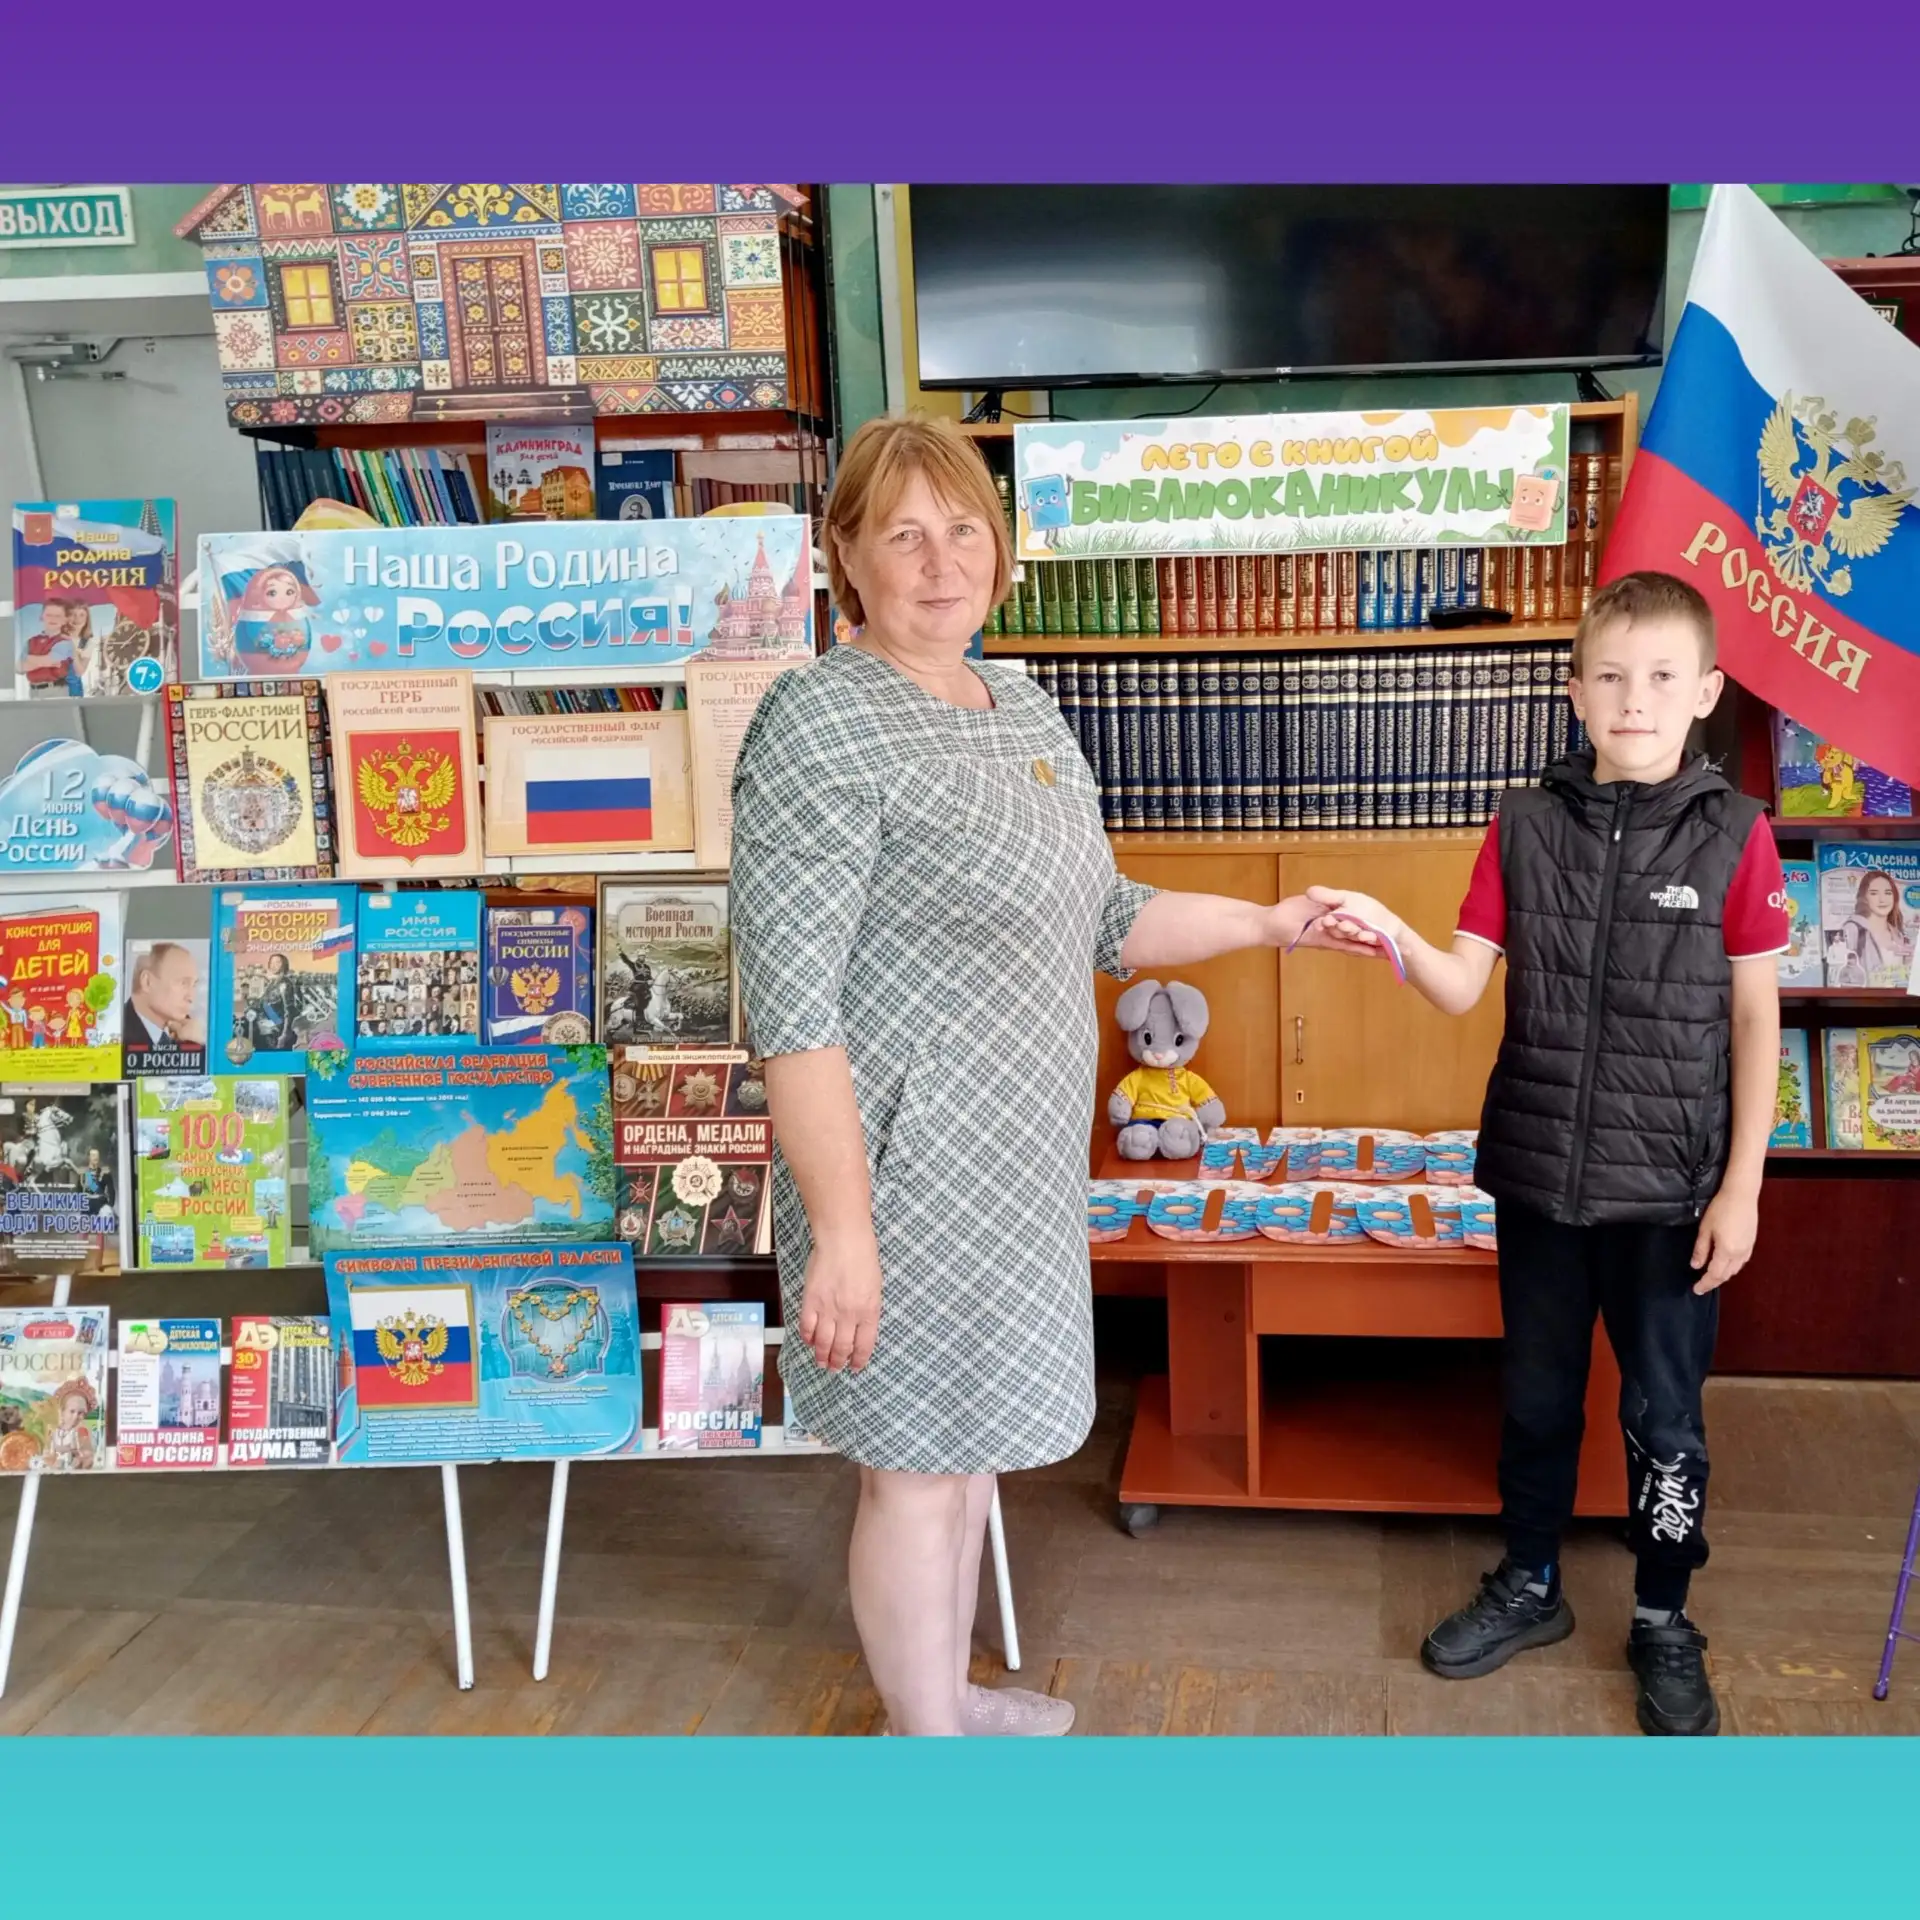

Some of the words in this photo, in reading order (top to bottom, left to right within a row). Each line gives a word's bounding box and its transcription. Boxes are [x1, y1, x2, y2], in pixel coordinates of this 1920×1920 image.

[0, 200, 119, 235] ВЫХОД
[496, 438, 583, 455] КАЛИНИНГРАД
[1141, 440, 1241, 472] ЛЕТО
[1249, 441, 1273, 467] С
[1281, 428, 1439, 465] КНИГОЙ
[1070, 466, 1515, 527] БИБЛИОКАНИКУЛЫ
[74, 530, 119, 543] Наша
[56, 549, 132, 567] родина
[344, 546, 481, 591] Наша
[497, 540, 679, 591] Родина
[44, 567, 147, 589] РОССИЯ
[1680, 521, 1872, 694] РОССИЯ
[135, 666, 158, 686] 7+
[341, 676, 458, 691] ГОСУДАРСТВЕННЫЙ
[700, 671, 780, 683] ГОСУДАРСТВЕ
[733, 681, 770, 695] ГИМ
[379, 690, 422, 704] ГЕРБ
[343, 706, 403, 716] РОССИЙСКОЙ
[406, 704, 460, 714] ФЕДЕРАЦИИ
[191, 719, 303, 743] РОССИИ
[512, 721, 625, 735] ГОСУДАРСТВЕННЫЙ
[630, 721, 661, 732] ФЛАГ
[531, 734, 588, 745] РОССИЙСКОЙ
[591, 734, 643, 744] ФЕДЕРАЦИИ
[1130, 713, 1140, 778] ЭНЦИКЛОПЕДИЯ
[1150, 713, 1160, 778] ЭНЦИКЛОПЕДИЯ
[1170, 713, 1180, 777] ЭНЦИКЛОПЕДИЯ
[1211, 712, 1220, 778] ЭНЦИКЛОПЕДИЯ
[1230, 712, 1240, 778] ЭНЦИКЛОПЕДИЯ
[1251, 712, 1260, 778] ЭНЦИКЛОПЕДИЯ
[1271, 712, 1279, 778] ЭНЦИКЛОПЕДИЯ
[1310, 710, 1318, 776] ЭНЦИКЛОПЕДИЯ
[1328, 711, 1336, 776] ЭНЦИКЛОПЕДИЯ
[1348, 709, 1356, 776] ЭНЦИКЛОПЕДИЯ
[1366, 710, 1375, 776] ЭНЦИКЛОПЕДИЯ
[1386, 709, 1394, 776] ЭНЦИКЛОПЕДИЯ
[1404, 708, 1412, 776] ЭНЦИКЛОПЕДИЯ
[1423, 708, 1432, 776] ЭНЦИКЛОПЕДИЯ
[1441, 707, 1450, 774] ЭНЦИКЛОПЕДИЯ
[1460, 706, 1468, 774] ЭНЦИКЛОПЕДИЯ
[1479, 706, 1488, 773] ЭНЦИКЛОПЕДИЯ
[1498, 704, 1508, 772] ЭНЦИКЛОПЕДИЯ
[43, 769, 87, 800] 12
[1112, 798, 1118, 806] 7
[1130, 798, 1137, 806] 8
[1150, 798, 1156, 806] 9
[1169, 798, 1180, 806] 10
[1189, 798, 1199, 806] 11
[1208, 797, 1219, 806] 12
[1228, 796, 1239, 806] 13
[1248, 796, 1259, 806] 14
[1268, 796, 1278, 806] 15
[1288, 796, 1299, 806] 16
[1306, 796, 1316, 804] 17
[1324, 796, 1335, 805] 18
[1344, 794, 1354, 804] 19
[1362, 795, 1374, 805] 20
[1381, 795, 1392, 804] 21
[1399, 795, 1410, 804] 22
[1416, 794, 1429, 803] 23
[1435, 794, 1446, 803] 24
[1454, 792, 1465, 802] 25
[1473, 792, 1484, 802] 26
[9, 814, 79, 839] День
[1650, 892, 1684, 901] NORTH
[1658, 900, 1684, 908] FACE
[243, 911, 328, 927] ИСТОРИЯ
[401, 915, 441, 926] ИМЯ
[645, 907, 694, 922] Военная
[6, 920, 93, 940] КОНСТИТУЦИЯ
[248, 927, 323, 942] РОССИИ
[384, 927, 457, 938] РОССИЯ
[501, 930, 570, 938] ГОСУДАРСТВЕННЫЕ
[625, 925, 672, 940] история
[675, 923, 714, 939] России
[37, 938, 61, 953] ДЛЯ
[246, 941, 325, 953] ЭНЦИКЛОПЕДИЯ
[501, 945, 569, 959] РОССИИ
[11, 948, 90, 981] ДЕТЕЙ
[152, 1043, 177, 1051] МЫСЛИ
[127, 1053, 137, 1068] О
[143, 1052, 200, 1068] РОССИИ
[355, 1053, 456, 1072] РОССИЙСКАЯ
[460, 1053, 548, 1070] ФЕДЕРАЦИЯ
[348, 1071, 442, 1089] СУВЕРЕННОЕ
[447, 1069, 554, 1087] ГОСУДАРСТВО
[179, 1111, 245, 1151] 100
[624, 1124, 692, 1144] ОРДЕНА,
[697, 1124, 766, 1143] МЕДАЛИ
[624, 1145, 631, 1155] И
[633, 1145, 692, 1156] НАГРАДНЫЕ
[694, 1144, 726, 1155] ЗНАКИ
[729, 1144, 766, 1154] РОССИИ
[176, 1152, 214, 1164] САМЫХ
[180, 1165, 245, 1177] ИНТЕРЕСНЫХ
[212, 1179, 250, 1194] МЕСТ
[6, 1192, 90, 1212] ВЕЛИКИЕ
[181, 1198, 248, 1217] РОССИИ
[0, 1214, 38, 1235] ЮДИ
[44, 1215, 115, 1233] РОССИИ
[336, 1257, 417, 1274] СИМВОЛЫ
[423, 1250, 554, 1272] ПРЕЗИДЕНТСКОЙ
[559, 1249, 622, 1266] ВЛАСТИ
[235, 1352, 255, 1362] 30
[663, 1410, 758, 1431] РОССИЯ,
[120, 1433, 154, 1445] НАША
[161, 1431, 205, 1444] РОДИНА
[231, 1427, 327, 1441] ГОСУДАРСТВЕННАЯ
[141, 1446, 213, 1463] РОССИЯ
[230, 1441, 297, 1462] ДУМА
